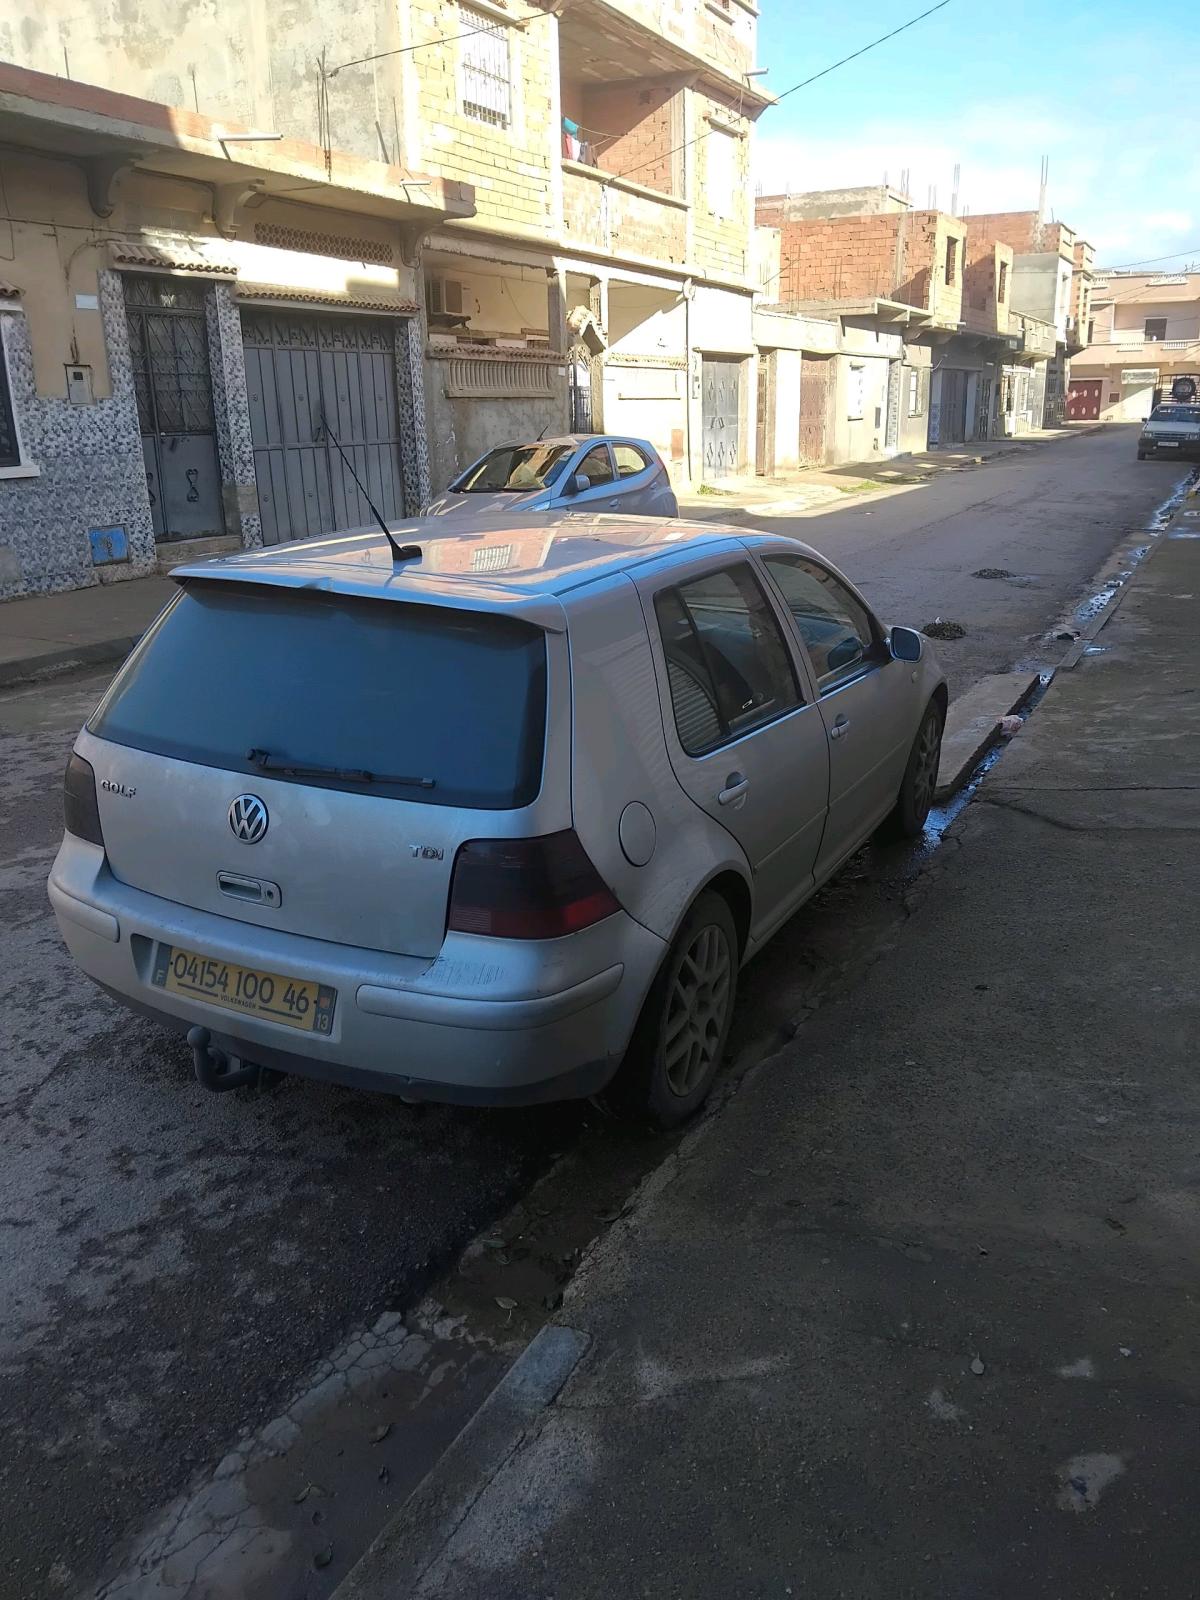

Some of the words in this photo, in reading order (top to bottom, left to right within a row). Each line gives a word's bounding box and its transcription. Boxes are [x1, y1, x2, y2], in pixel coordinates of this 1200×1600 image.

[101, 780, 136, 799] GOLF
[409, 844, 445, 861] TDI
[174, 952, 228, 993] 04154
[236, 970, 275, 1004] 100
[283, 983, 309, 1014] 46
